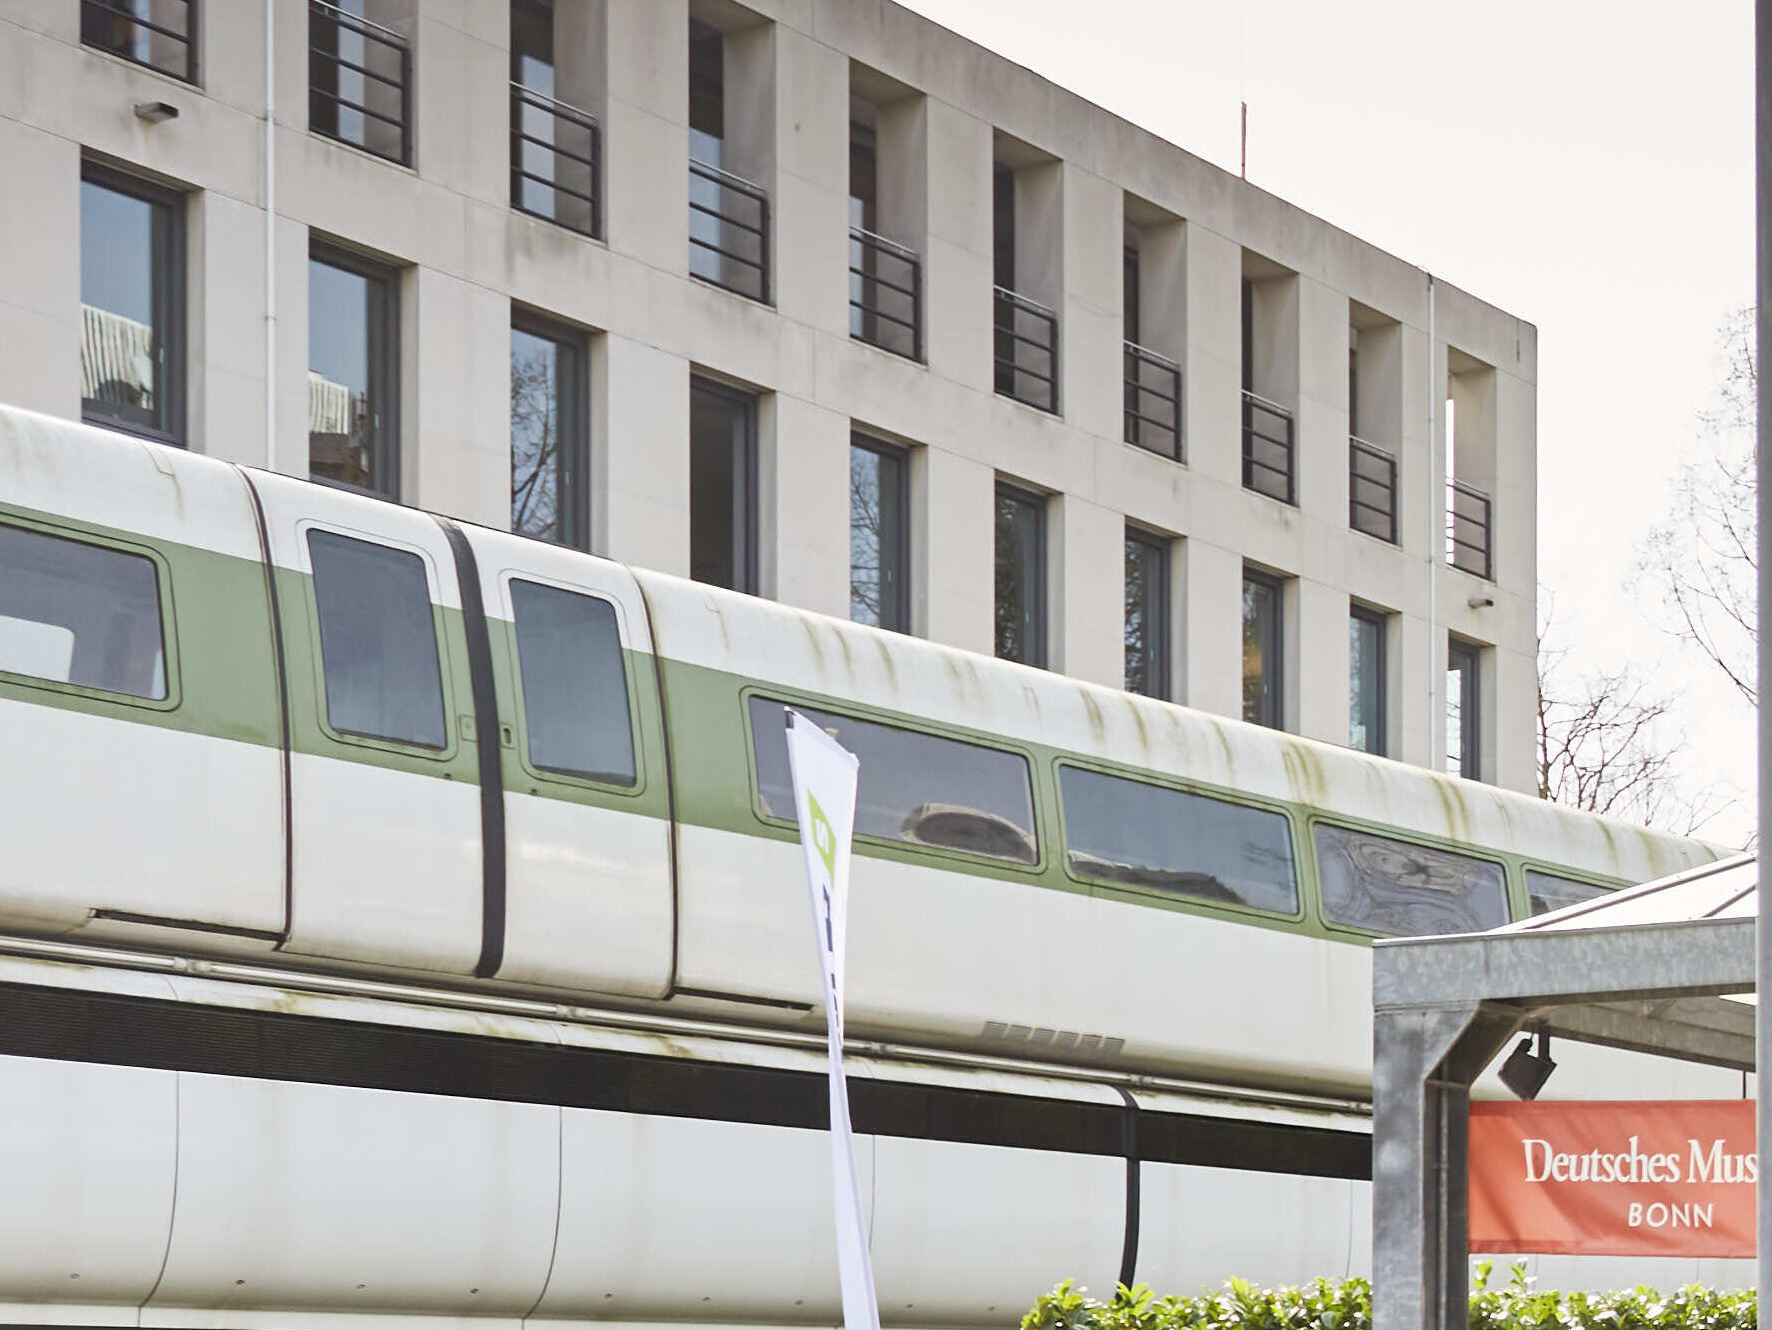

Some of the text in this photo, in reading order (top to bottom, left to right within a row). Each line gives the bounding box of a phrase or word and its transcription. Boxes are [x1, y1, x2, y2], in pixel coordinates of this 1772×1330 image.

[1521, 1136, 1759, 1184] Deutsches Mus
[1628, 1203, 1713, 1228] BONN
